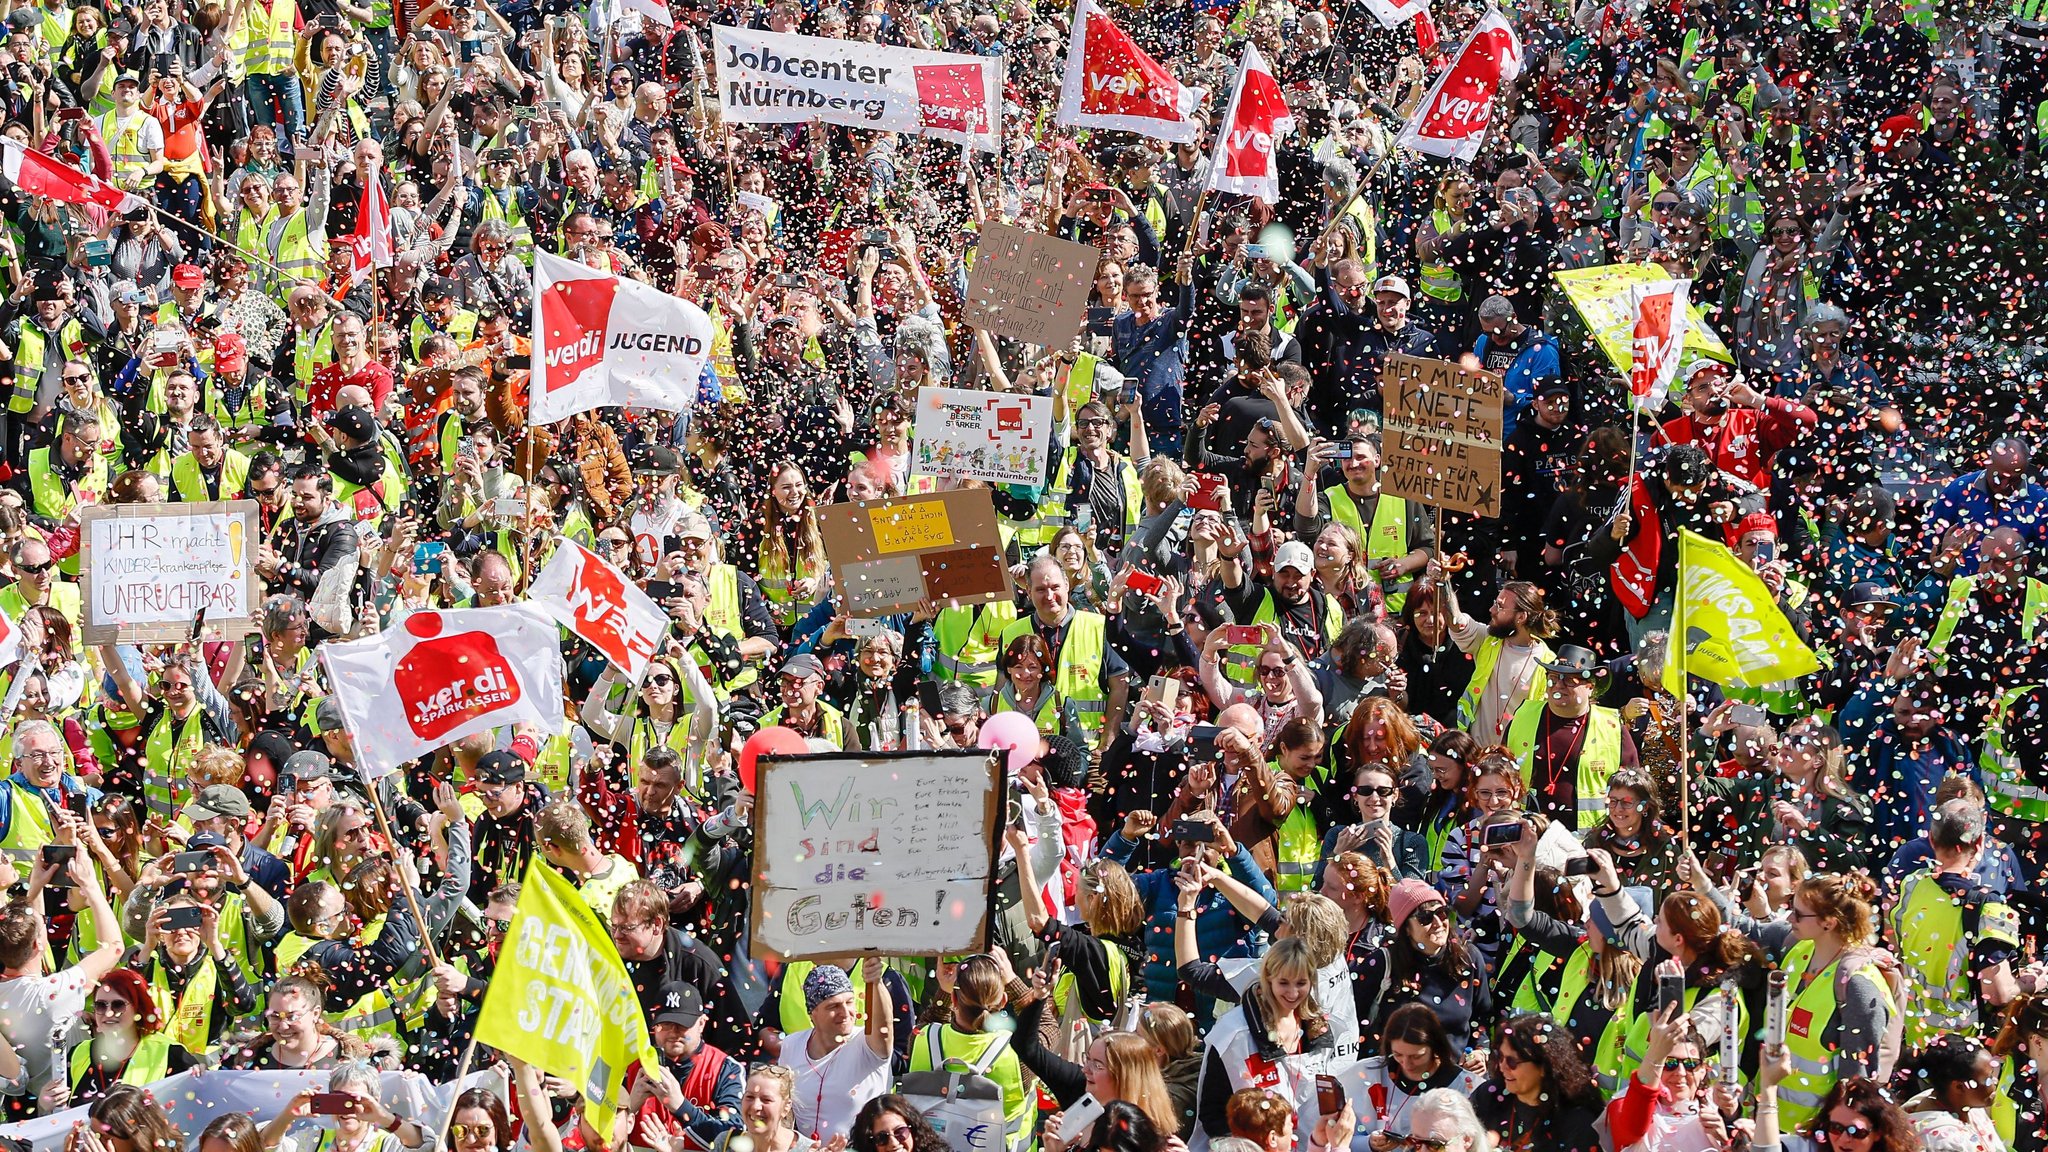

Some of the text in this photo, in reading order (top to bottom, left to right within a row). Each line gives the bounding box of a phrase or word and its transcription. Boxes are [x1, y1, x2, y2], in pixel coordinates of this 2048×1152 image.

[727, 44, 892, 85] Jobcenter
[730, 81, 886, 121] Nürnberg
[1030, 247, 1058, 274] eine
[1040, 280, 1065, 303] mit
[610, 333, 703, 356] JUGEND
[1387, 361, 1500, 399] HER MIT DER
[1399, 384, 1486, 428] KNETE,
[1388, 413, 1413, 429] UND
[1417, 417, 1456, 437] ZWAR
[1399, 430, 1469, 460] LÖHNE
[972, 469, 995, 479] Stadt
[996, 472, 1038, 484] Nürnberg
[1387, 454, 1481, 485] STATT FÜR
[1392, 471, 1471, 503] WAFFEN
[108, 524, 162, 551] IHR
[170, 531, 226, 549] macht
[102, 581, 237, 616] UNFRUCHTBAR
[1698, 647, 1729, 664] JUGEND
[415, 666, 508, 717] ver.di
[421, 691, 511, 727] SPARKASSEN
[789, 776, 898, 831] Wir
[799, 827, 881, 859] sind
[815, 863, 866, 885] die
